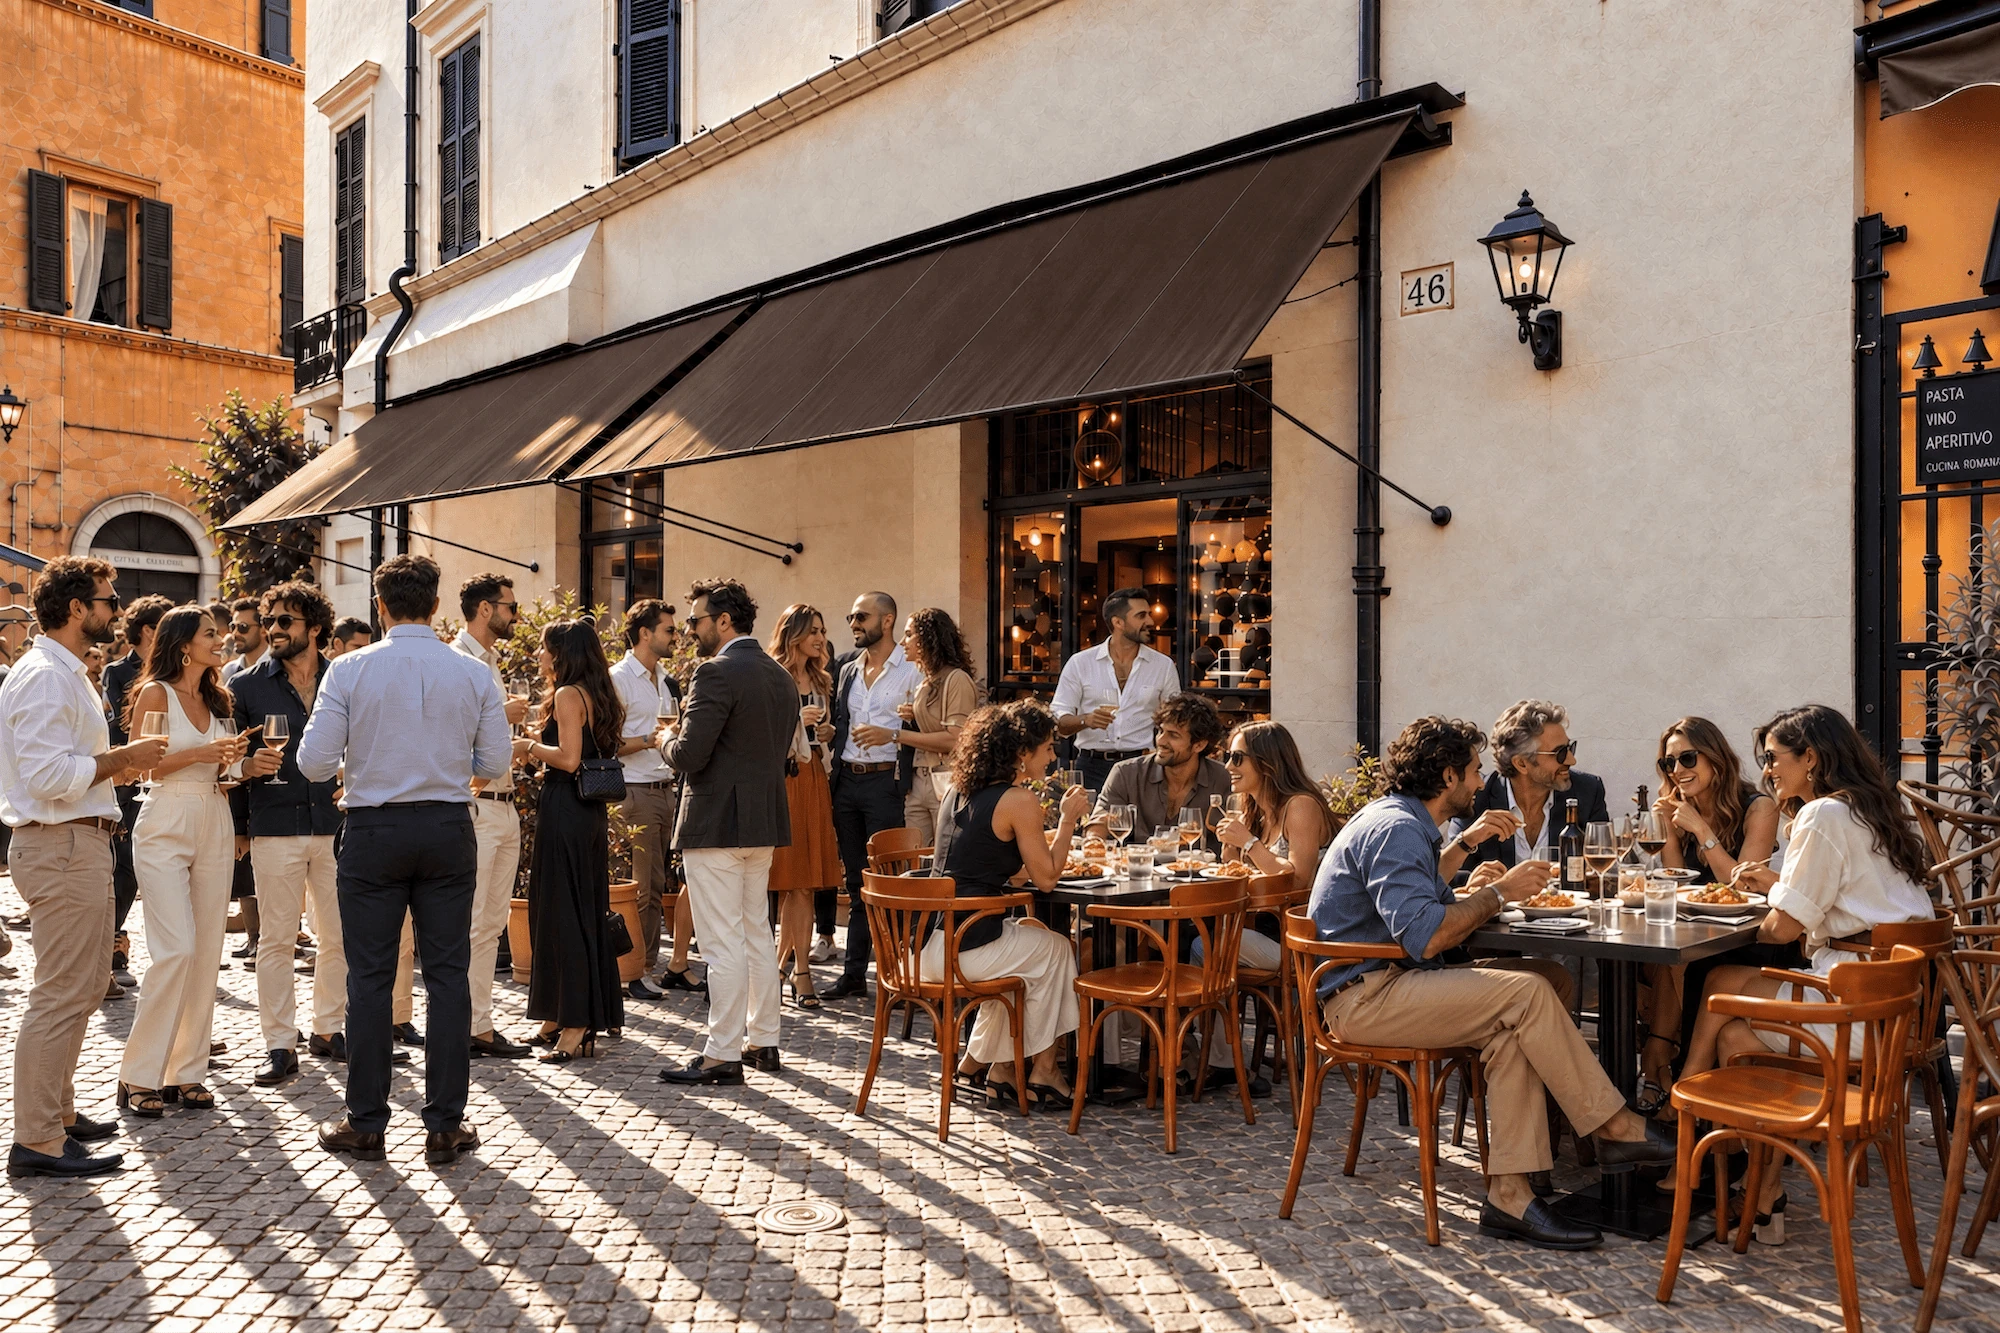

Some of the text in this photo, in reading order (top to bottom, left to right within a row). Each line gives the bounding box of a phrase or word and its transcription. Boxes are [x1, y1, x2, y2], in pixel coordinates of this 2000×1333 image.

[1407, 274, 1445, 307] 46
[1926, 387, 1965, 404] PASTA
[1925, 410, 1957, 427] VINO
[1925, 430, 1993, 451] APERITIVO
[1926, 460, 1960, 473] CUCINA
